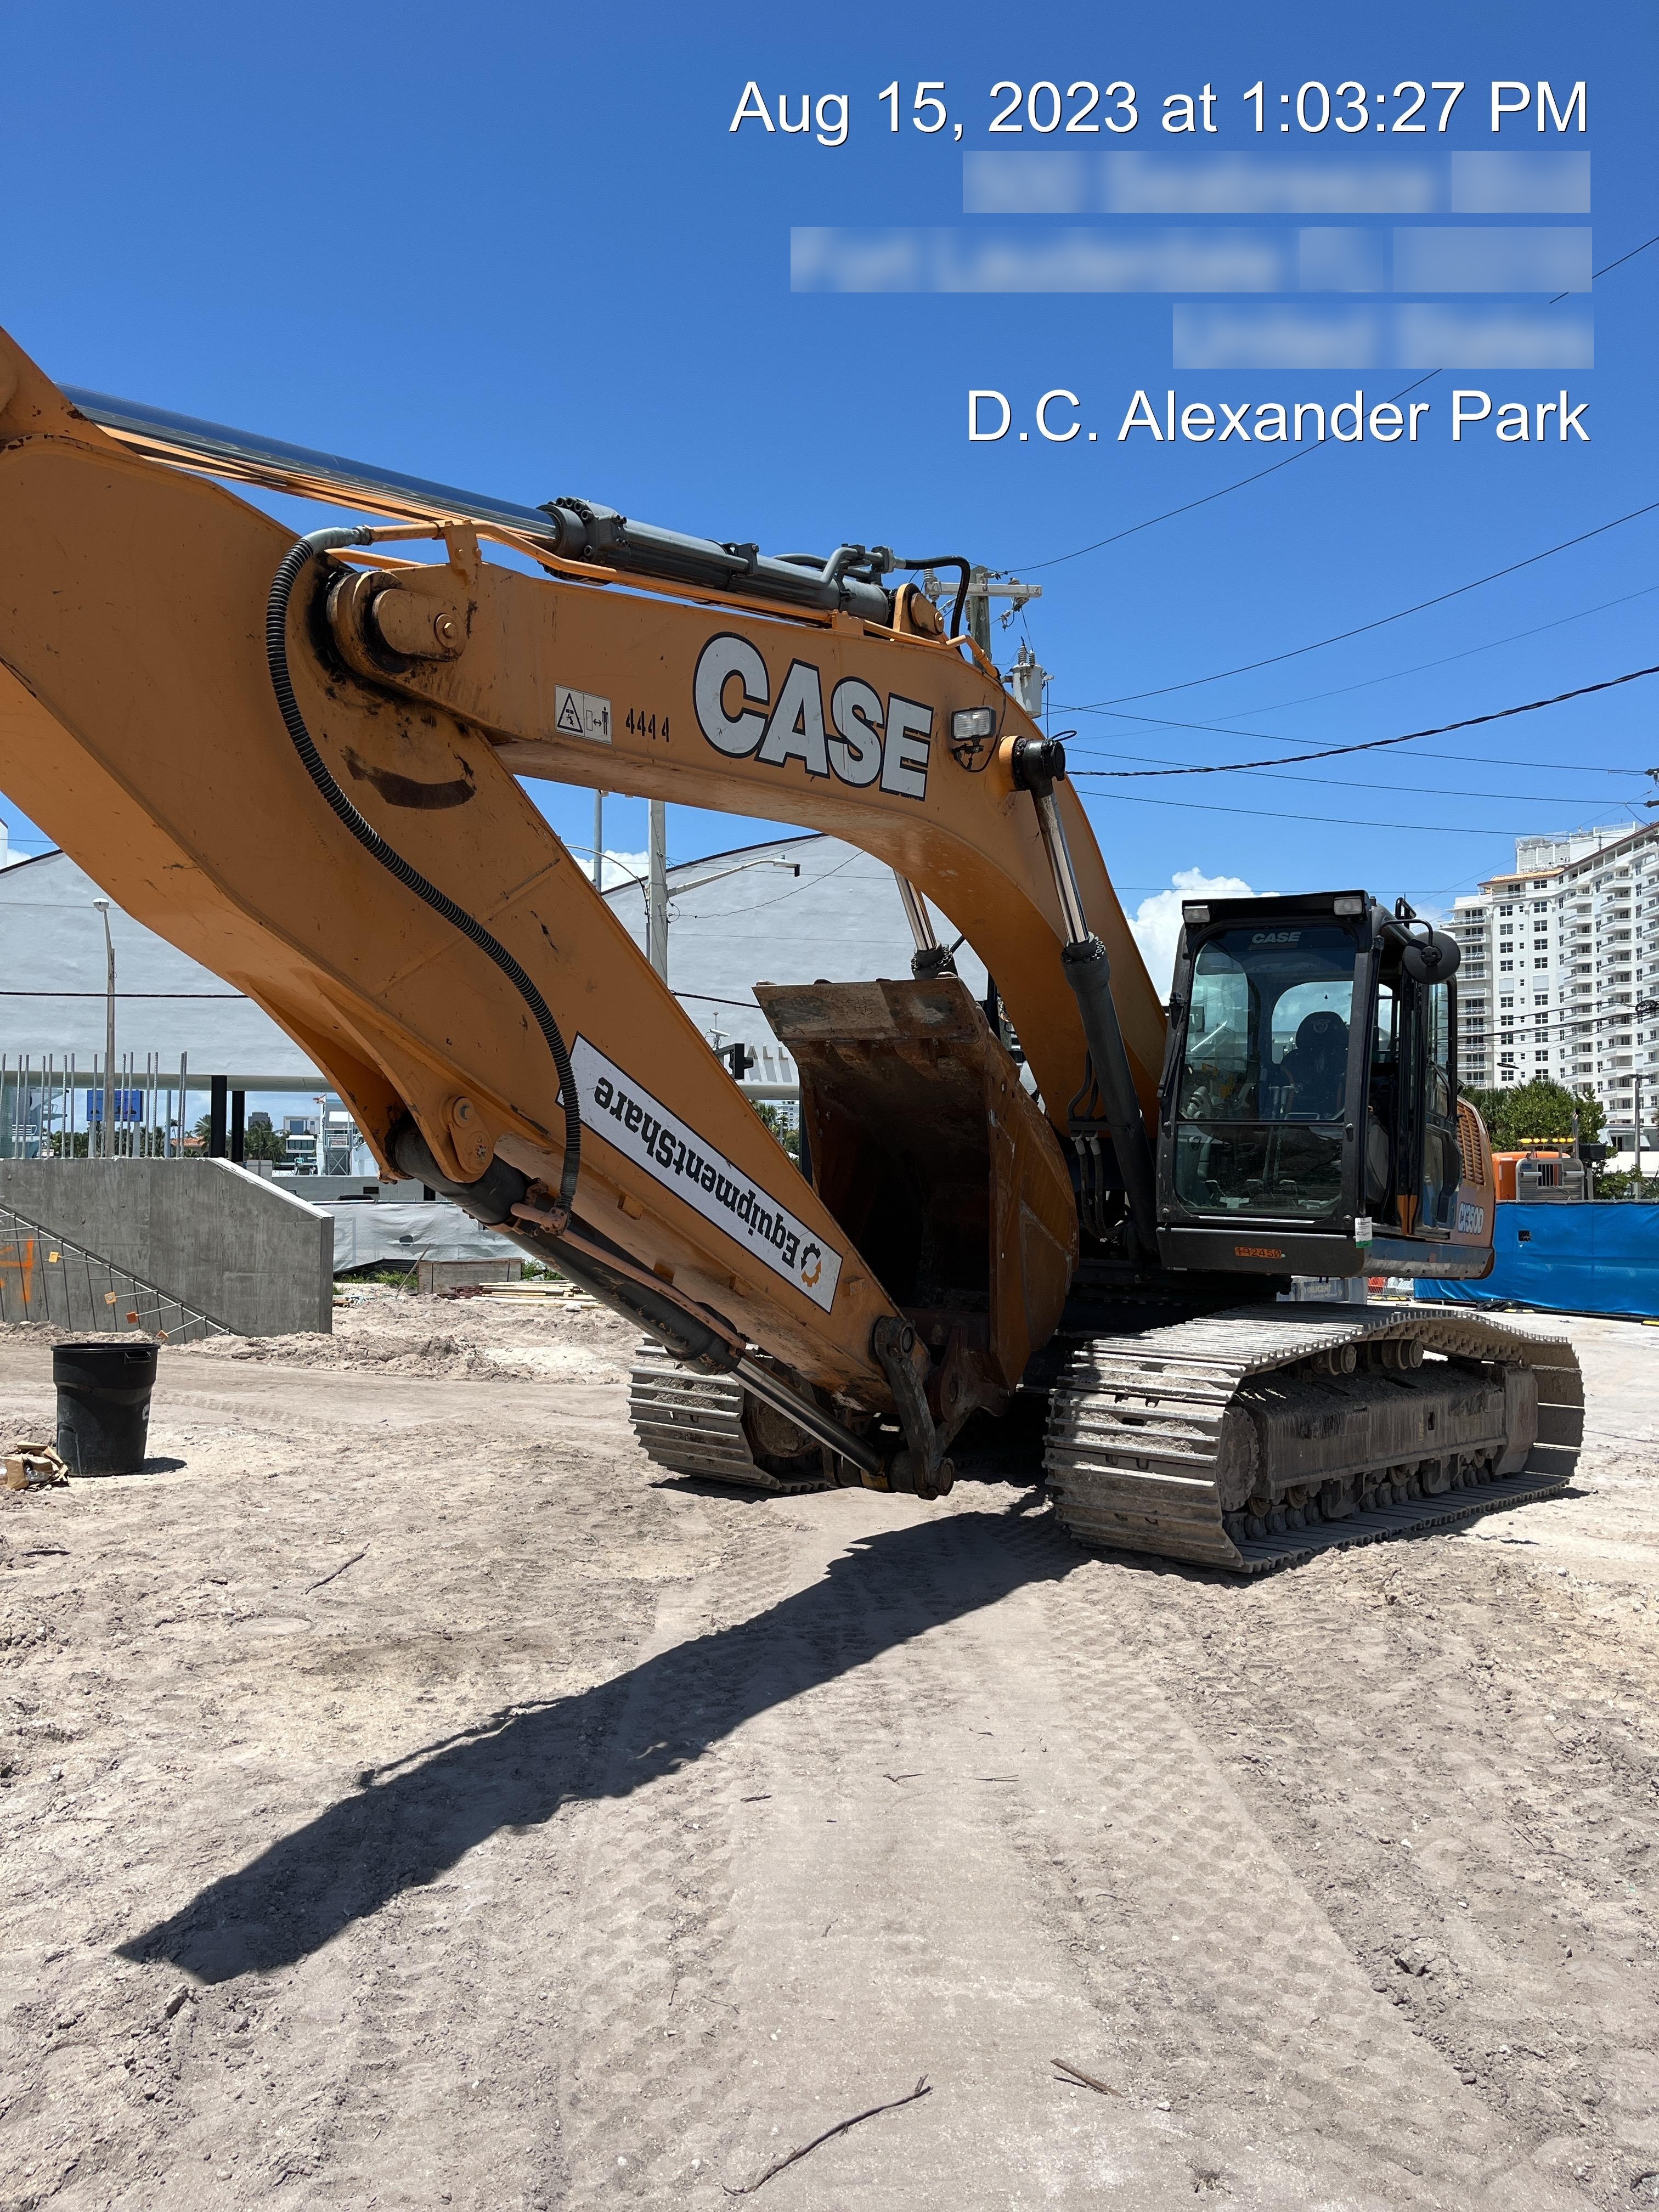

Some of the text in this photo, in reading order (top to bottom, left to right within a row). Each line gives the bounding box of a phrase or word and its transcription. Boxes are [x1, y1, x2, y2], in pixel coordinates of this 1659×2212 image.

[625, 708, 670, 743] 4444
[693, 631, 934, 801] CASE
[1251, 931, 1302, 944] CASE
[747, 1045, 789, 1060] ALL
[594, 1076, 800, 1269] EquipmentShare
